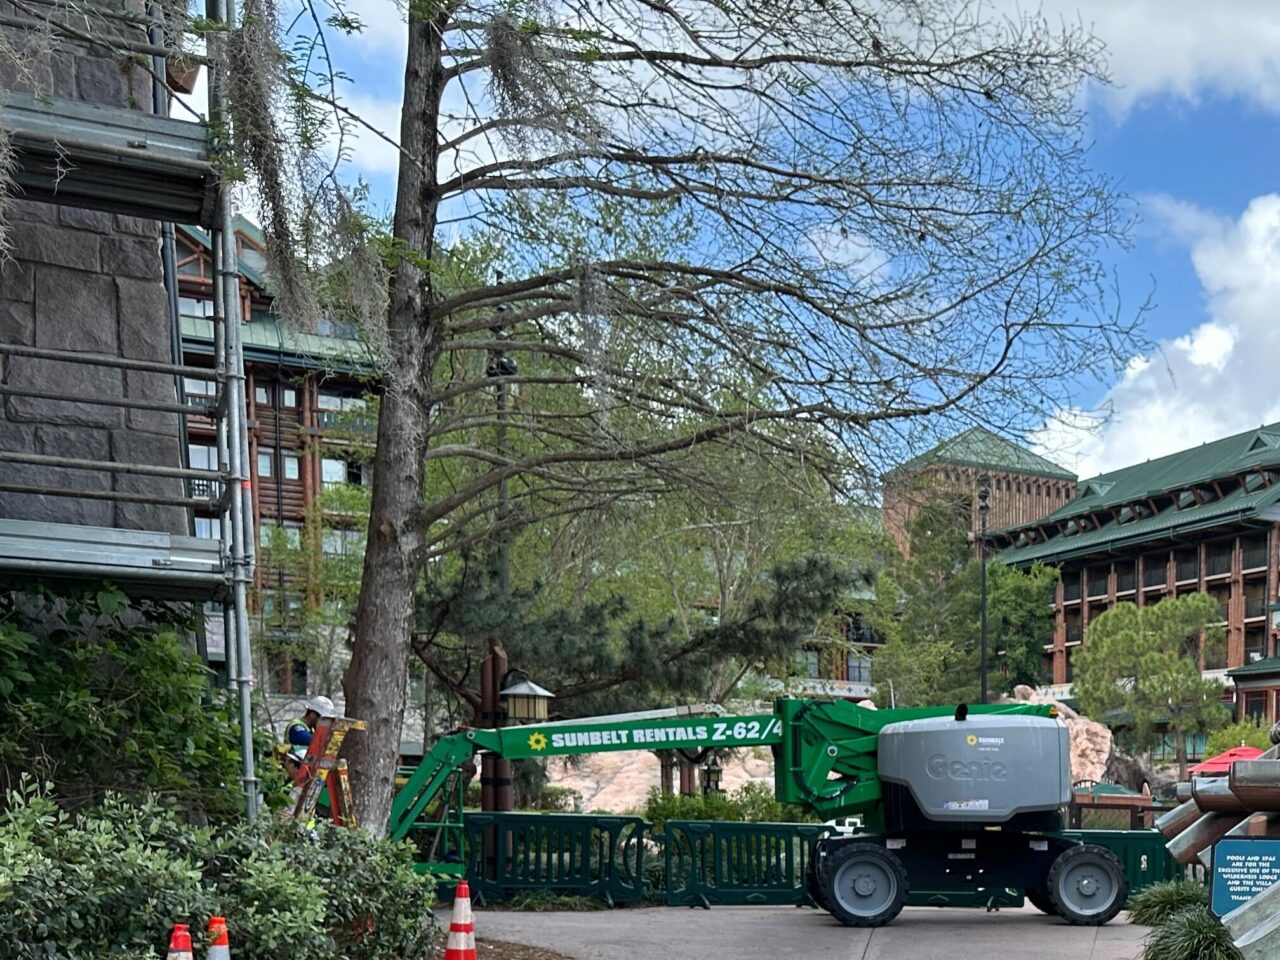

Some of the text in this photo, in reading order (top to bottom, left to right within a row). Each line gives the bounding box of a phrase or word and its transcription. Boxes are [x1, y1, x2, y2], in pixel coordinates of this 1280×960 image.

[551, 730, 629, 748] SUNBELT
[633, 725, 708, 743] RENTALS
[925, 753, 1007, 781] Genie
